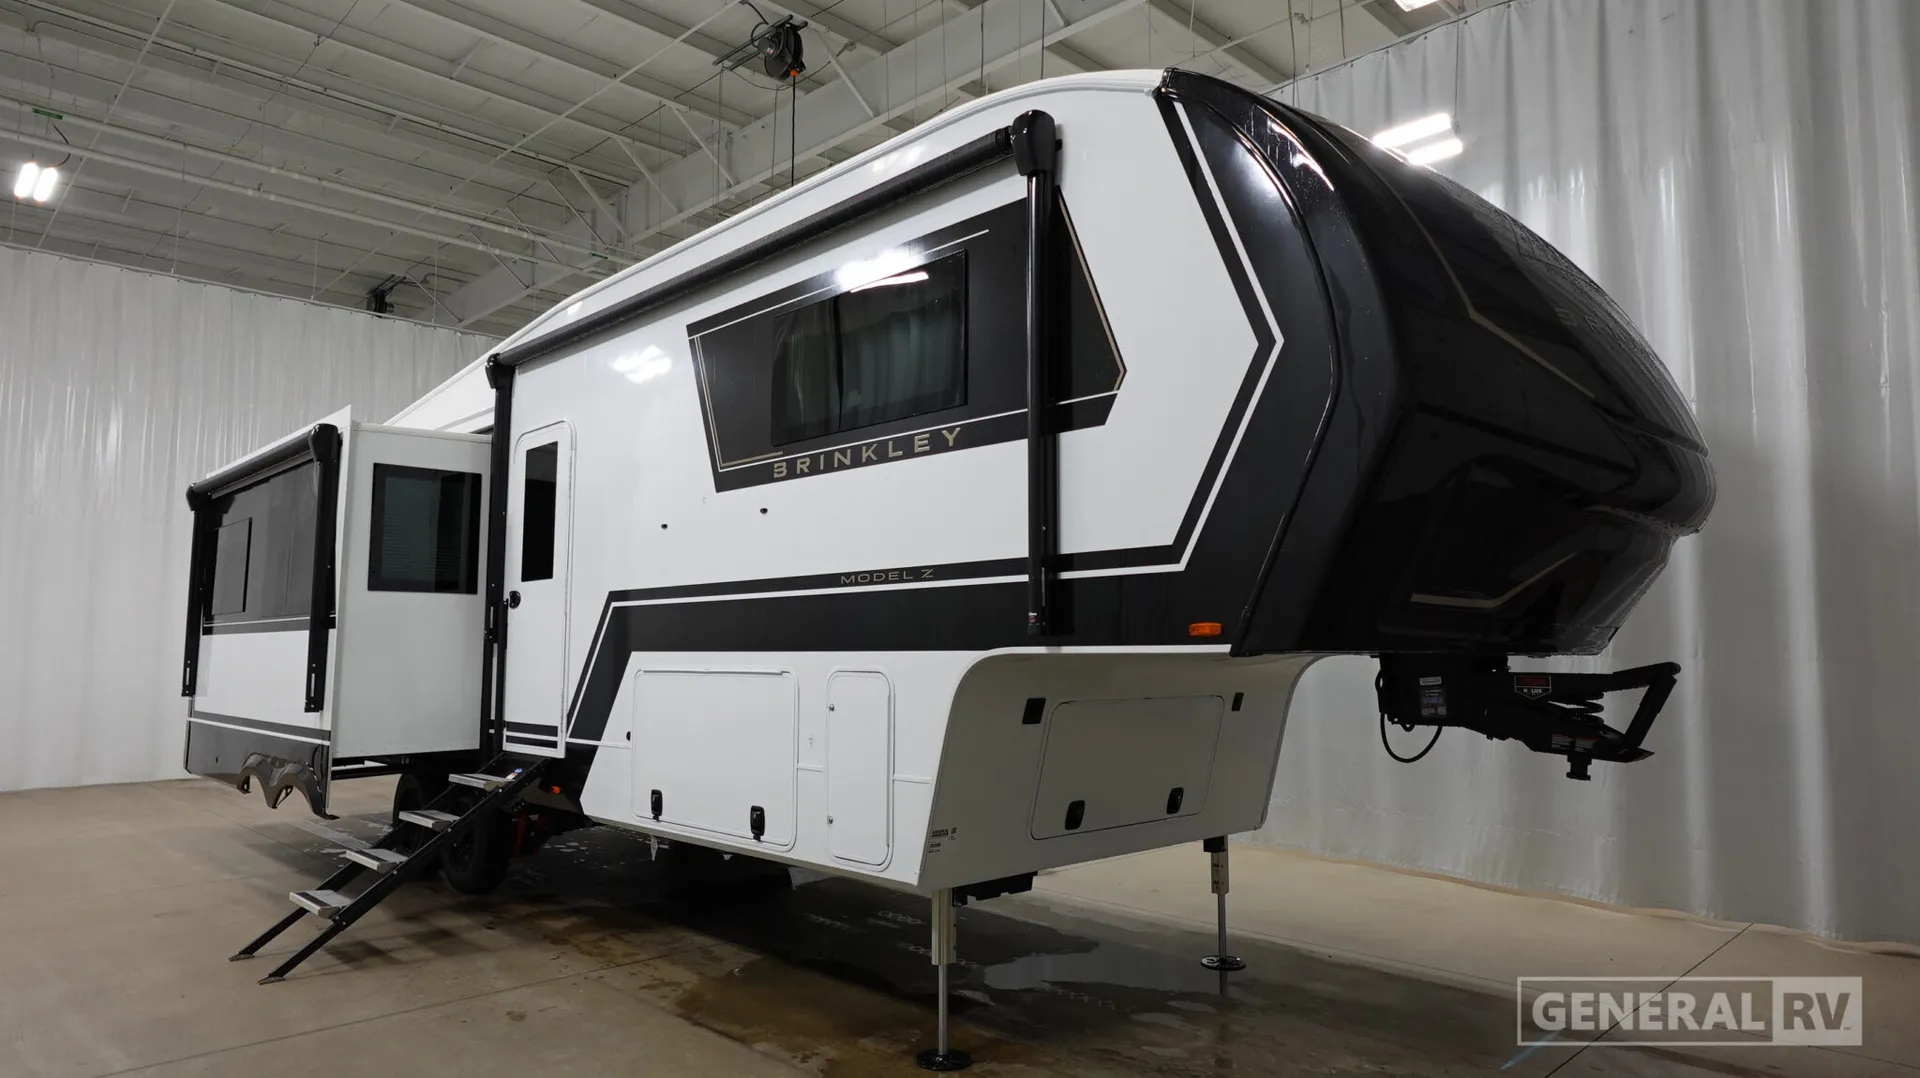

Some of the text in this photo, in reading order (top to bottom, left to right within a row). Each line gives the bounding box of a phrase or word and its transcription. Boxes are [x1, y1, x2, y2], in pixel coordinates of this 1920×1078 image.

[773, 427, 961, 479] BRINKLEY
[840, 568, 934, 585] MODEL Z
